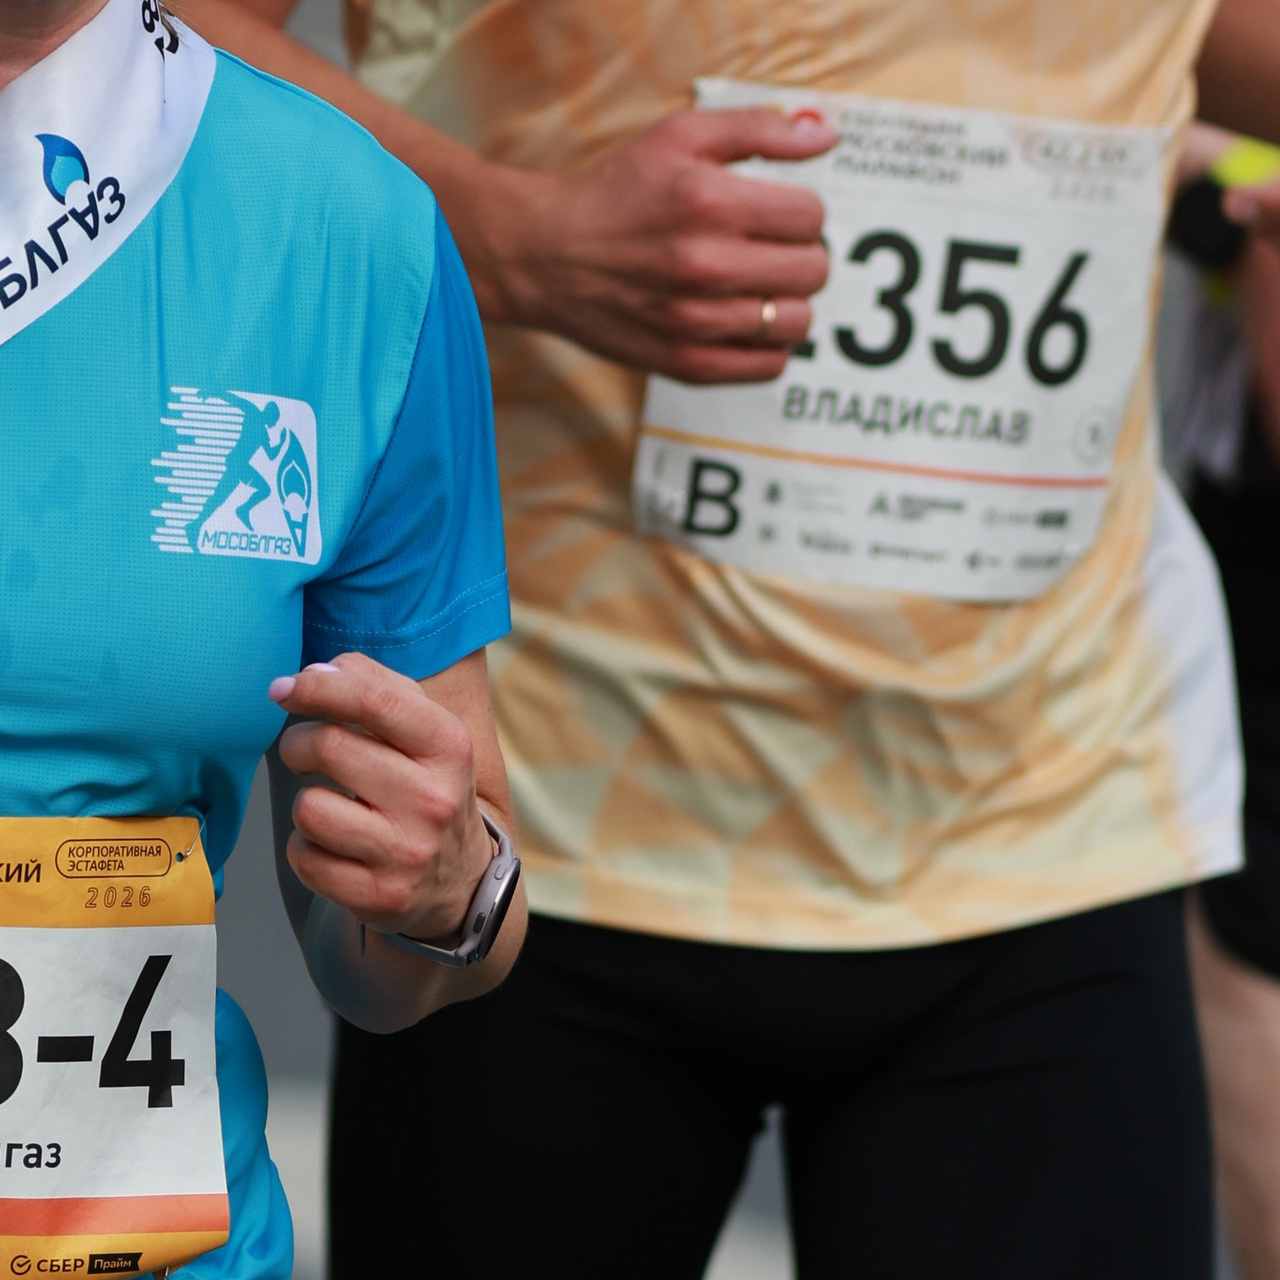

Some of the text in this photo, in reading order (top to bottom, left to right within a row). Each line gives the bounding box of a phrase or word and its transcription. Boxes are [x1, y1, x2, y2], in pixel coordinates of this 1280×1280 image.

[792, 228, 1090, 388] 356
[783, 386, 1032, 446] ВЛАДИСЛАВ
[201, 529, 293, 556] МОСОБЛГАЗ
[67, 844, 162, 859] КОРПОРАТИВНАЯ
[67, 859, 125, 872] ЭСТАФЕТА
[85, 885, 151, 908] 2026
[36, 1258, 132, 1273] СБЕР Прайм
